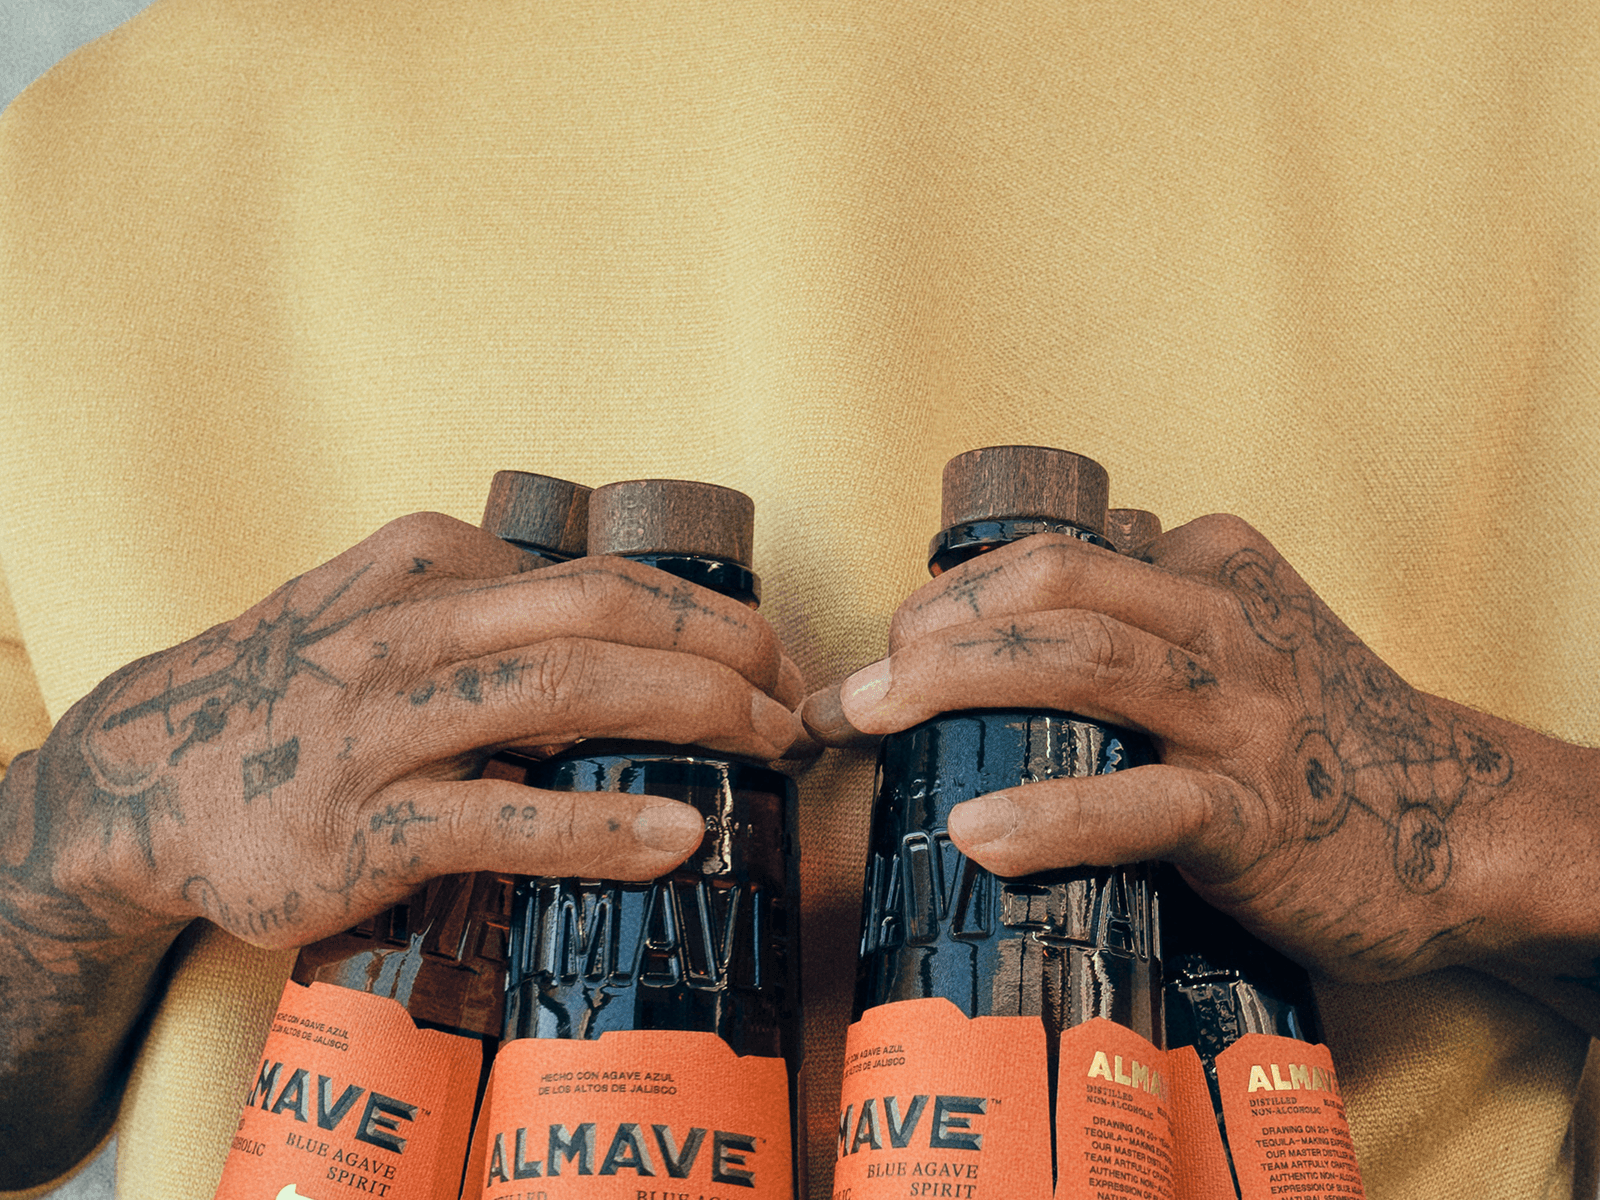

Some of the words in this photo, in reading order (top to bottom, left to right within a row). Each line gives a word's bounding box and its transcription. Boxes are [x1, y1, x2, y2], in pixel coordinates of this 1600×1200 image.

[300, 1019, 325, 1031] AGAVE
[326, 1026, 349, 1039] AZUL
[313, 1036, 349, 1051] JALISCO
[883, 1045, 904, 1054] AZUL
[873, 1057, 906, 1068] JALISCO
[541, 1072, 573, 1082] HECHO
[576, 1072, 599, 1080] CON
[602, 1072, 640, 1080] AGAVE
[644, 1072, 675, 1082] AZUL
[552, 1085, 571, 1094] LOS
[574, 1084, 608, 1093] ALTOS
[612, 1084, 626, 1092] DE
[630, 1084, 677, 1095] JALISCO
[1086, 1084, 1134, 1102] DISTILLED
[246, 1059, 418, 1155] MAVE
[1086, 1094, 1154, 1120] NON-ALCOHOLIC
[1249, 1097, 1297, 1107] DISTILLED
[1251, 1106, 1322, 1117] NON-ALCOHOLIC
[1093, 1116, 1133, 1133] DRAWING
[1262, 1126, 1303, 1135] DRAWING
[286, 1132, 329, 1157] BLUE
[332, 1149, 397, 1180] AGAVE
[486, 1122, 756, 1188] ALMAVE
[1092, 1141, 1112, 1152] OUR
[1114, 1146, 1146, 1162] MASTER
[1266, 1150, 1286, 1159] OUR
[1288, 1148, 1321, 1157] MASTER
[866, 1162, 908, 1178] BLUE
[912, 1163, 978, 1179] AGAVE
[1084, 1152, 1111, 1164] TEAM
[1114, 1158, 1151, 1175] ARTFULLY
[1260, 1162, 1288, 1171] TEAM
[1291, 1160, 1329, 1168] ARTFULLY
[326, 1166, 391, 1197] SPIRIT
[1090, 1166, 1139, 1184] AUTHENTIC
[1270, 1172, 1318, 1183] AUTHENTIC
[910, 1182, 977, 1199] SPIRIT
[1089, 1177, 1142, 1197] EXPRESSION
[1271, 1183, 1325, 1194] EXPRESSION
